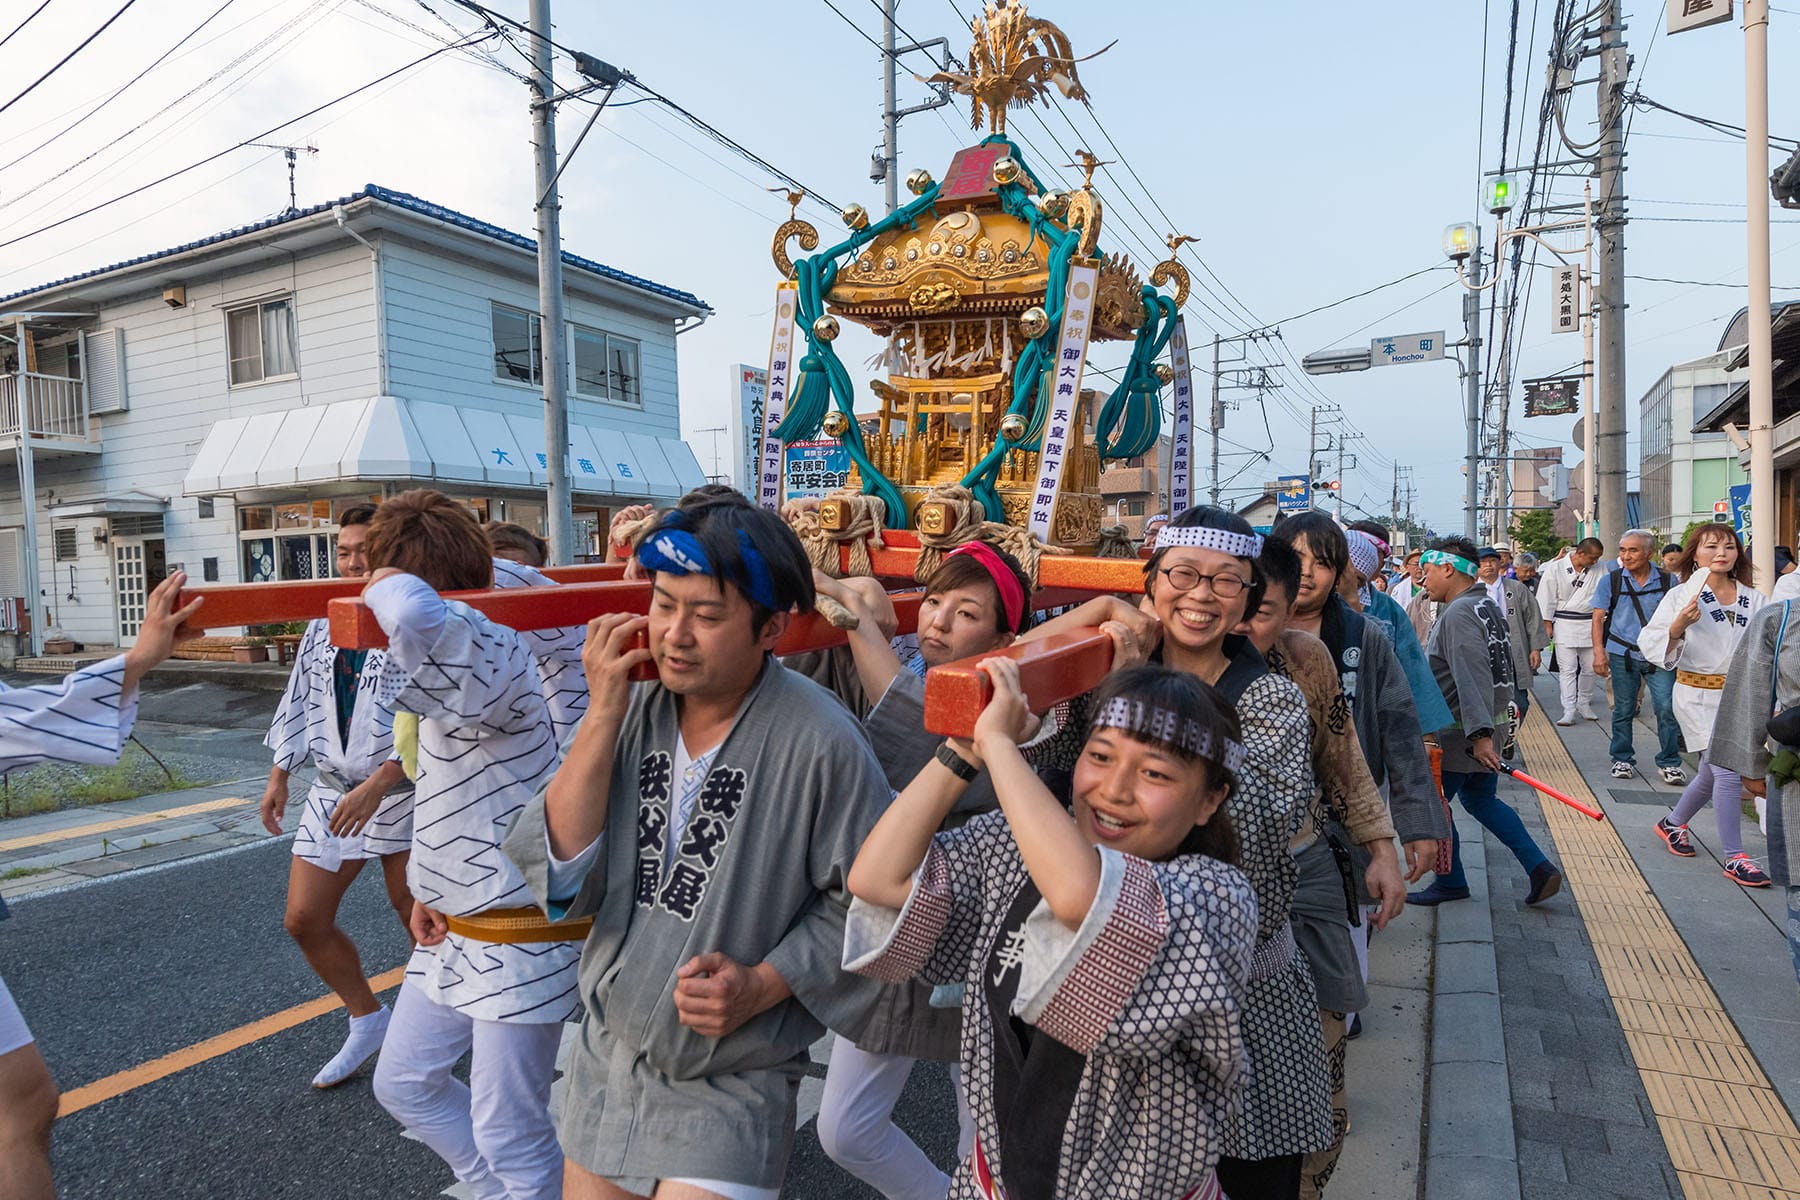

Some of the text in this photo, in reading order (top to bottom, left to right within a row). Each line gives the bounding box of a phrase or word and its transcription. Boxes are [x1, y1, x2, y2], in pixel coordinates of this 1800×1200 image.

[1560, 271, 1572, 327] 茶処大黒園
[1057, 347, 1081, 397] 御大典
[1382, 339, 1433, 355] 本町
[1392, 353, 1424, 362] Honchou
[771, 360, 786, 401] 御大典
[791, 460, 826, 472] 寄居町
[1033, 409, 1068, 523] 天皇陛下御即位
[1173, 434, 1188, 520] 天皇陛下御即
[658, 764, 747, 921] 秩父屋
